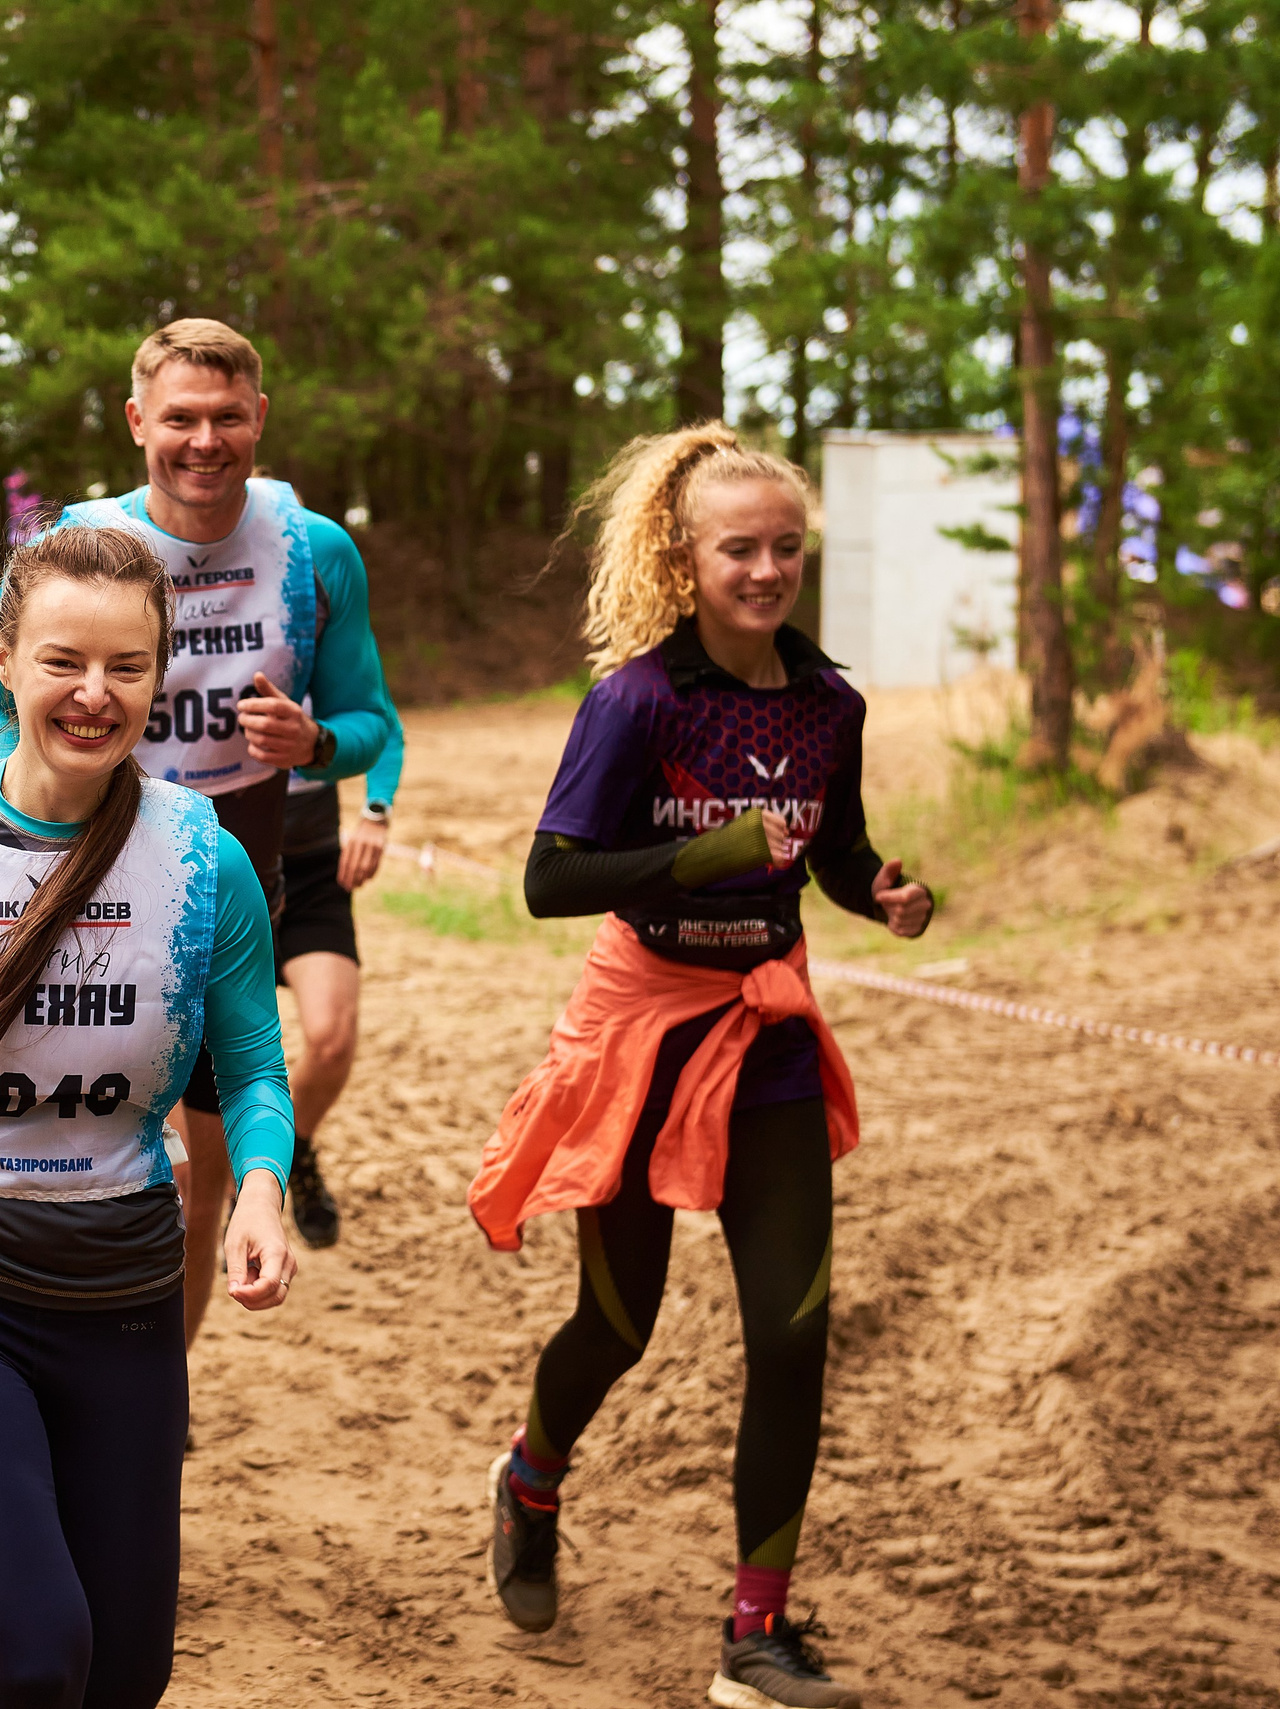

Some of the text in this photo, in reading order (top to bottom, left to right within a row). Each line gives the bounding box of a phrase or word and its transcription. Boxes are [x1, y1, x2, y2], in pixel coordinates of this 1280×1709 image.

[196, 567, 255, 586] ГЕРОЕВ
[678, 918, 767, 934] ИНСТРУКТОР
[678, 932, 769, 947] ГОНКА ГЕРОЕВ
[24, 983, 137, 1026] ЕХАУ
[0, 1156, 94, 1174] ГАЗПРОМБАНК
